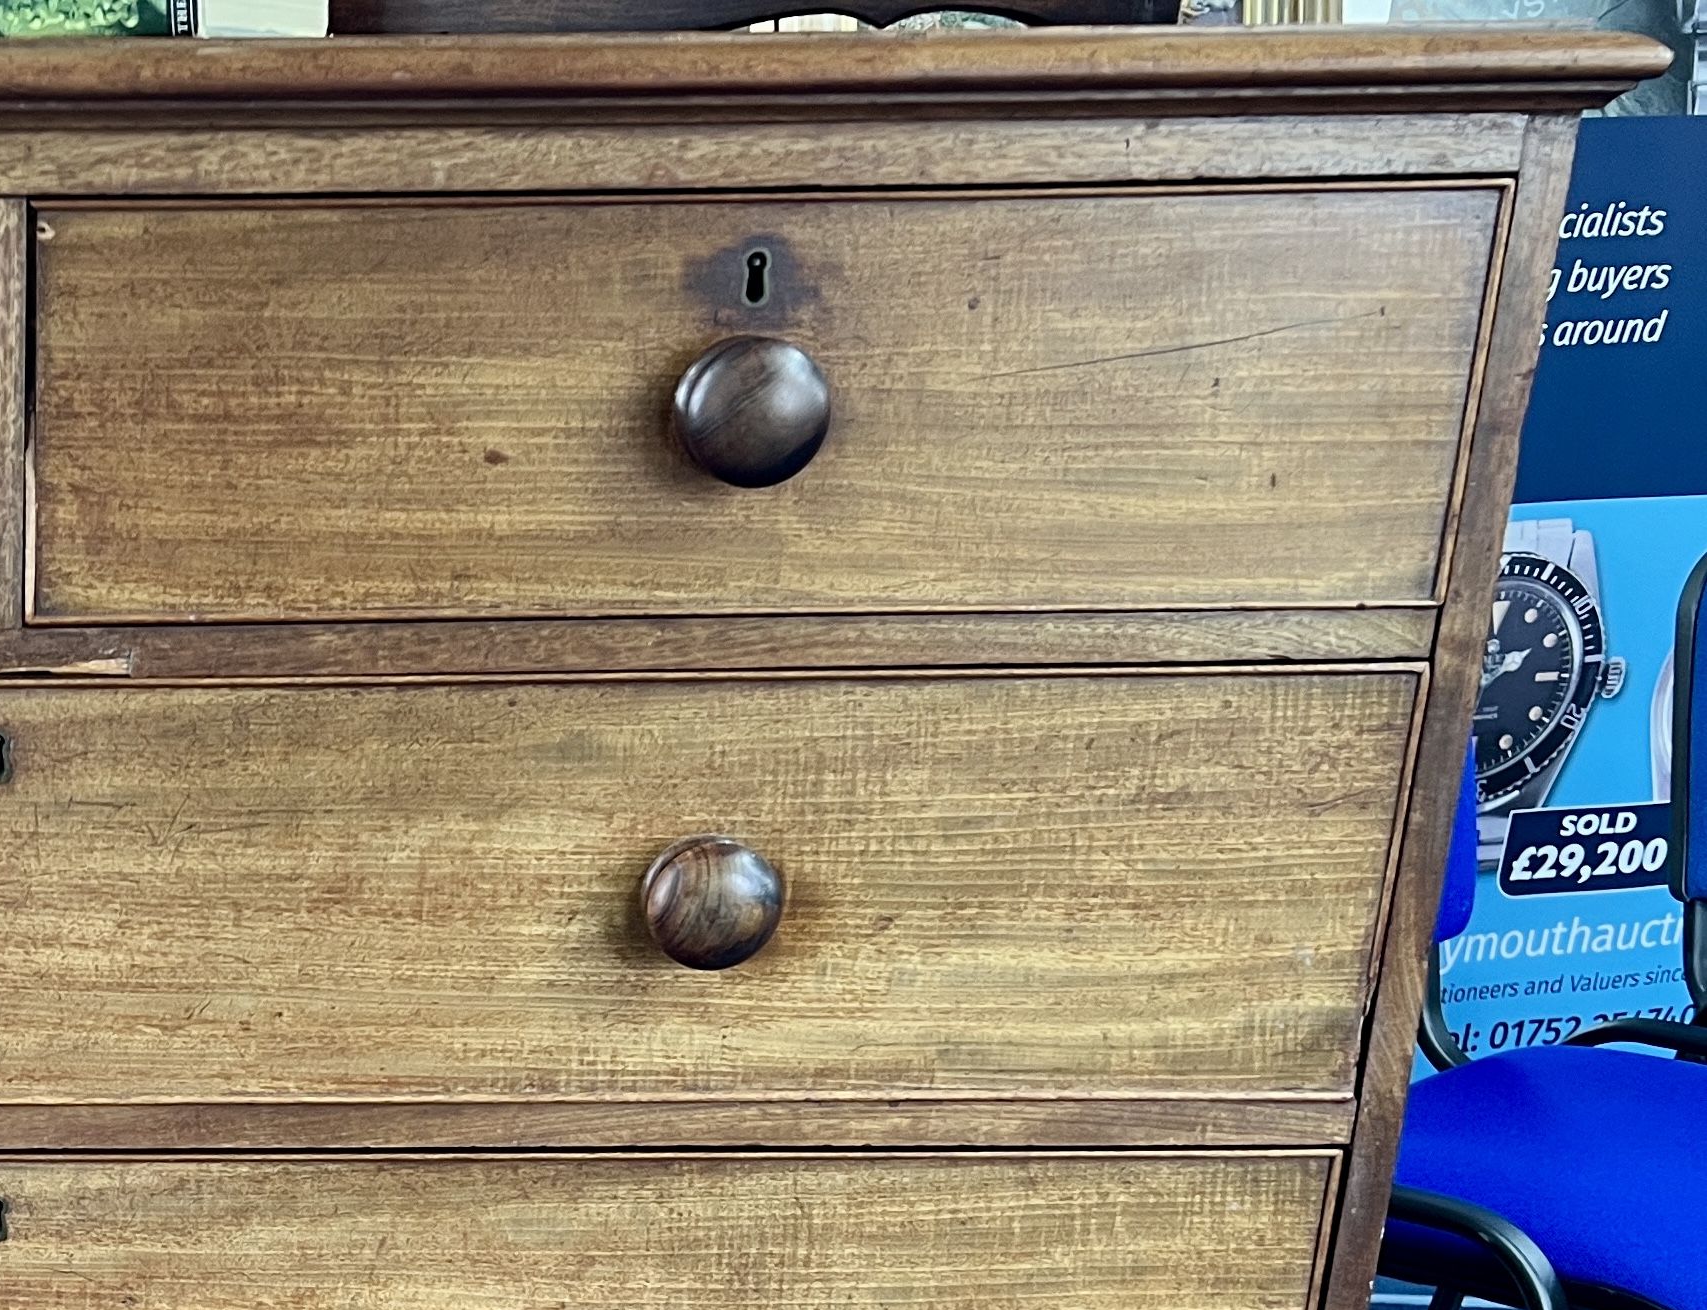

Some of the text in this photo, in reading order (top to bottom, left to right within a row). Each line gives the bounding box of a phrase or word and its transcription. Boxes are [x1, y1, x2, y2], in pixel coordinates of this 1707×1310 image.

[1558, 201, 1667, 239] cialists
[1566, 258, 1672, 300] buyers
[1552, 309, 1670, 347] around
[1559, 811, 1638, 837] SOLD
[1509, 837, 1669, 884] £29,200
[1524, 974, 1565, 996] and
[1570, 971, 1641, 993] Valuers
